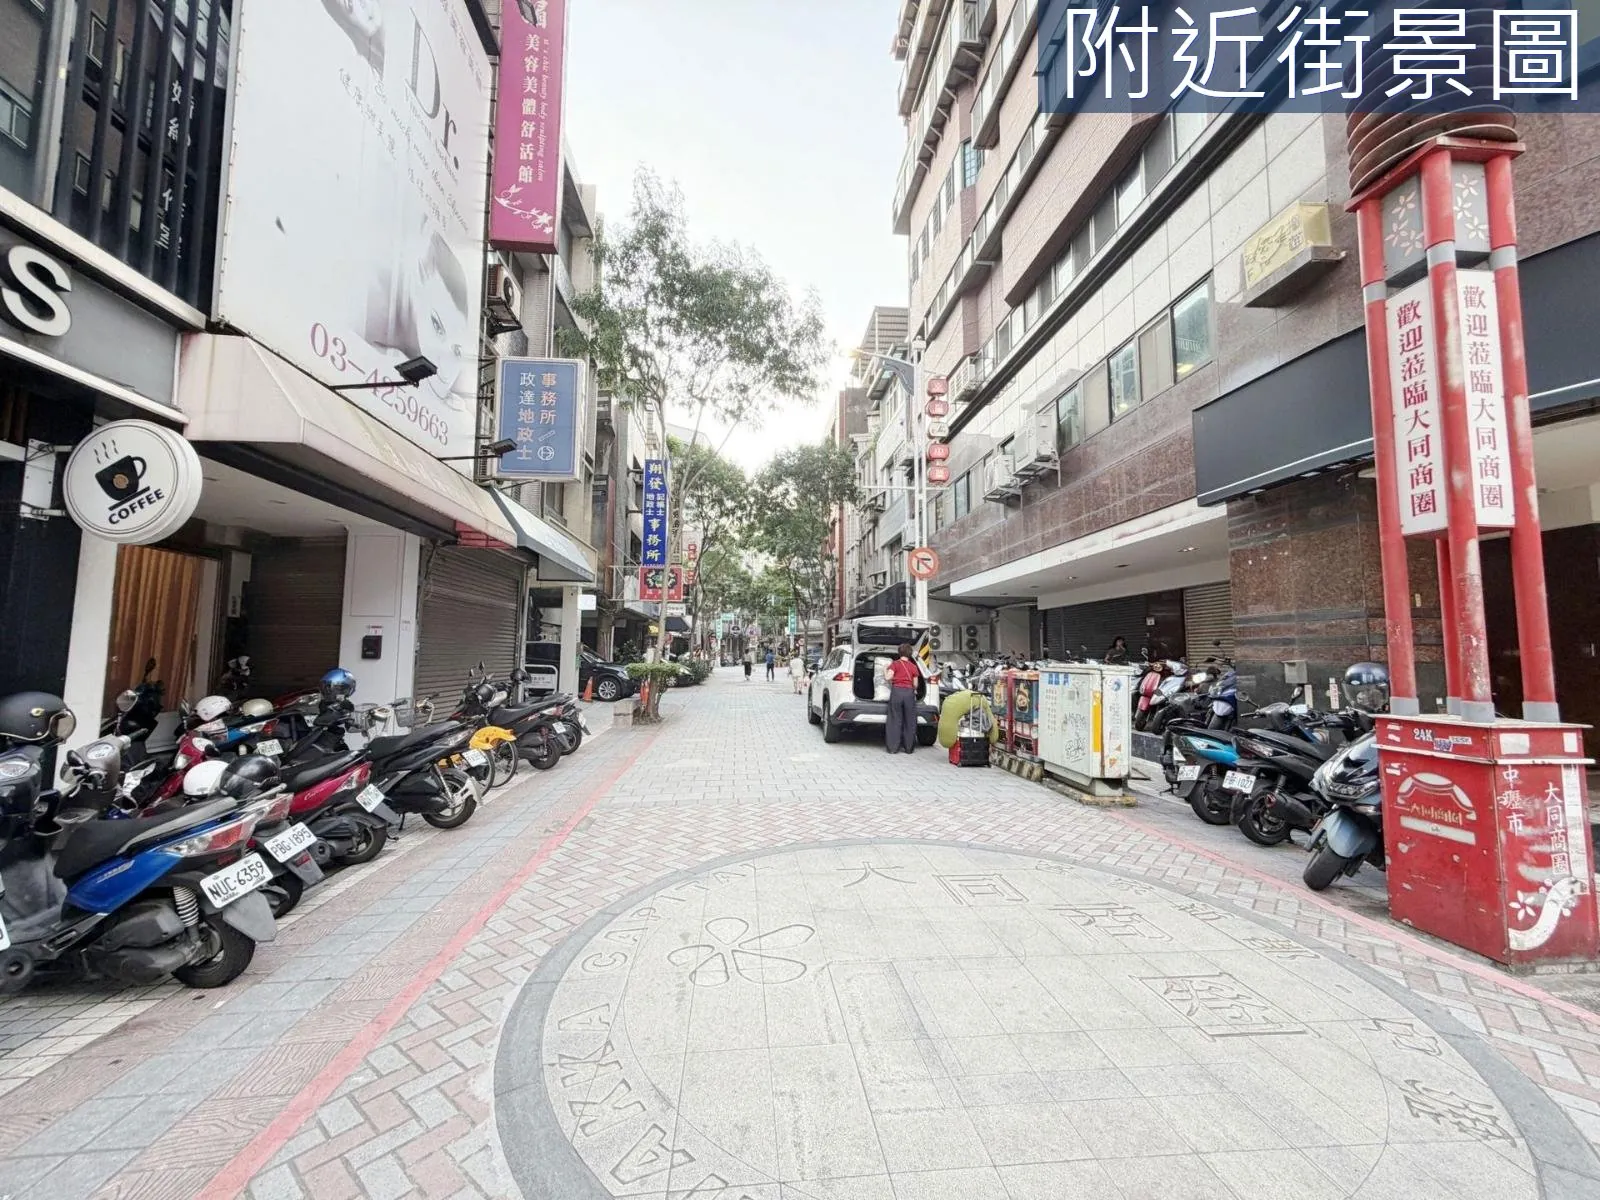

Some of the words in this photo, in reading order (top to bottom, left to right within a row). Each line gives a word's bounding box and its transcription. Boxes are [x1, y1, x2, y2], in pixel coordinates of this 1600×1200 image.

[404, 7, 460, 170] Dr.
[518, 33, 540, 184] 美容美體舒活館
[310, 322, 449, 447] 03-4259663
[516, 372, 536, 461] 政達地政士
[539, 373, 558, 426] 事務所
[1396, 299, 1437, 517] 歡迎蒞臨大同商圈
[1463, 285, 1505, 510] 歡迎蒞臨大同商圈
[108, 488, 165, 525] COFFEE
[1497, 765, 1525, 836] 中壢市
[1544, 782, 1573, 875] 大同商圈
